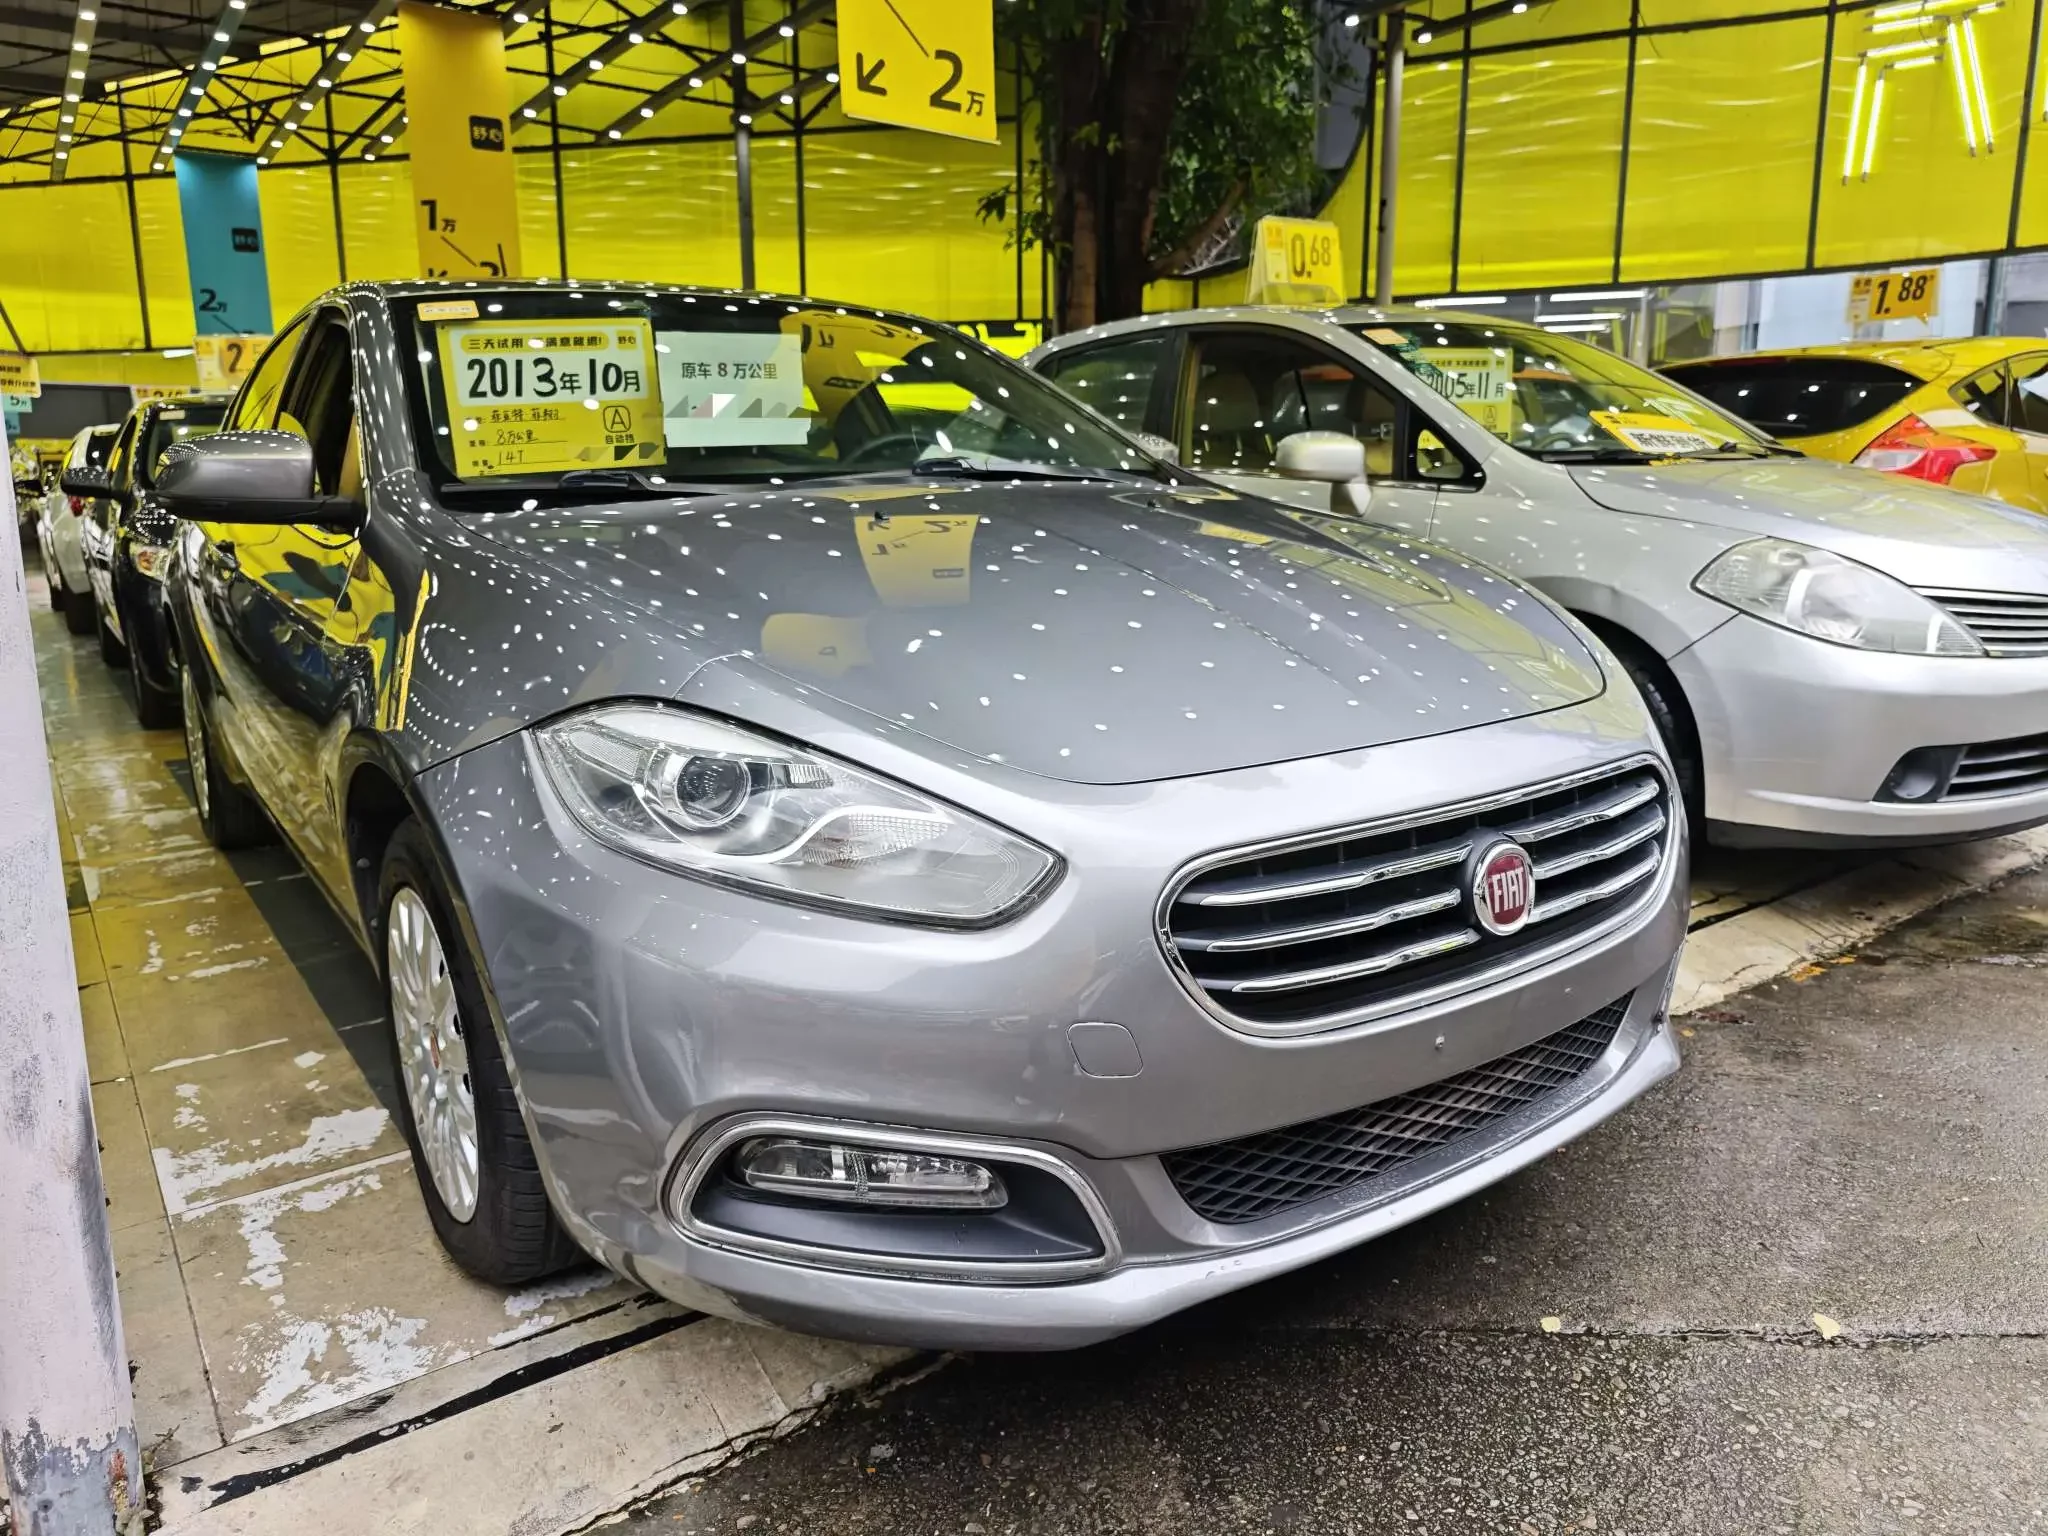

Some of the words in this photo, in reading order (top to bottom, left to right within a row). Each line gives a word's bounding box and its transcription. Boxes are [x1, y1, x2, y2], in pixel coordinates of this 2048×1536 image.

[929, 49, 986, 117] 2万
[1291, 233, 1332, 279] 0.68
[469, 338, 524, 350] 三天试用
[528, 335, 602, 349] 满意就退!
[467, 357, 641, 399] 2013年10月
[681, 362, 712, 379] 原车
[733, 362, 777, 380] 万公里
[1492, 866, 1524, 914] FIAT
